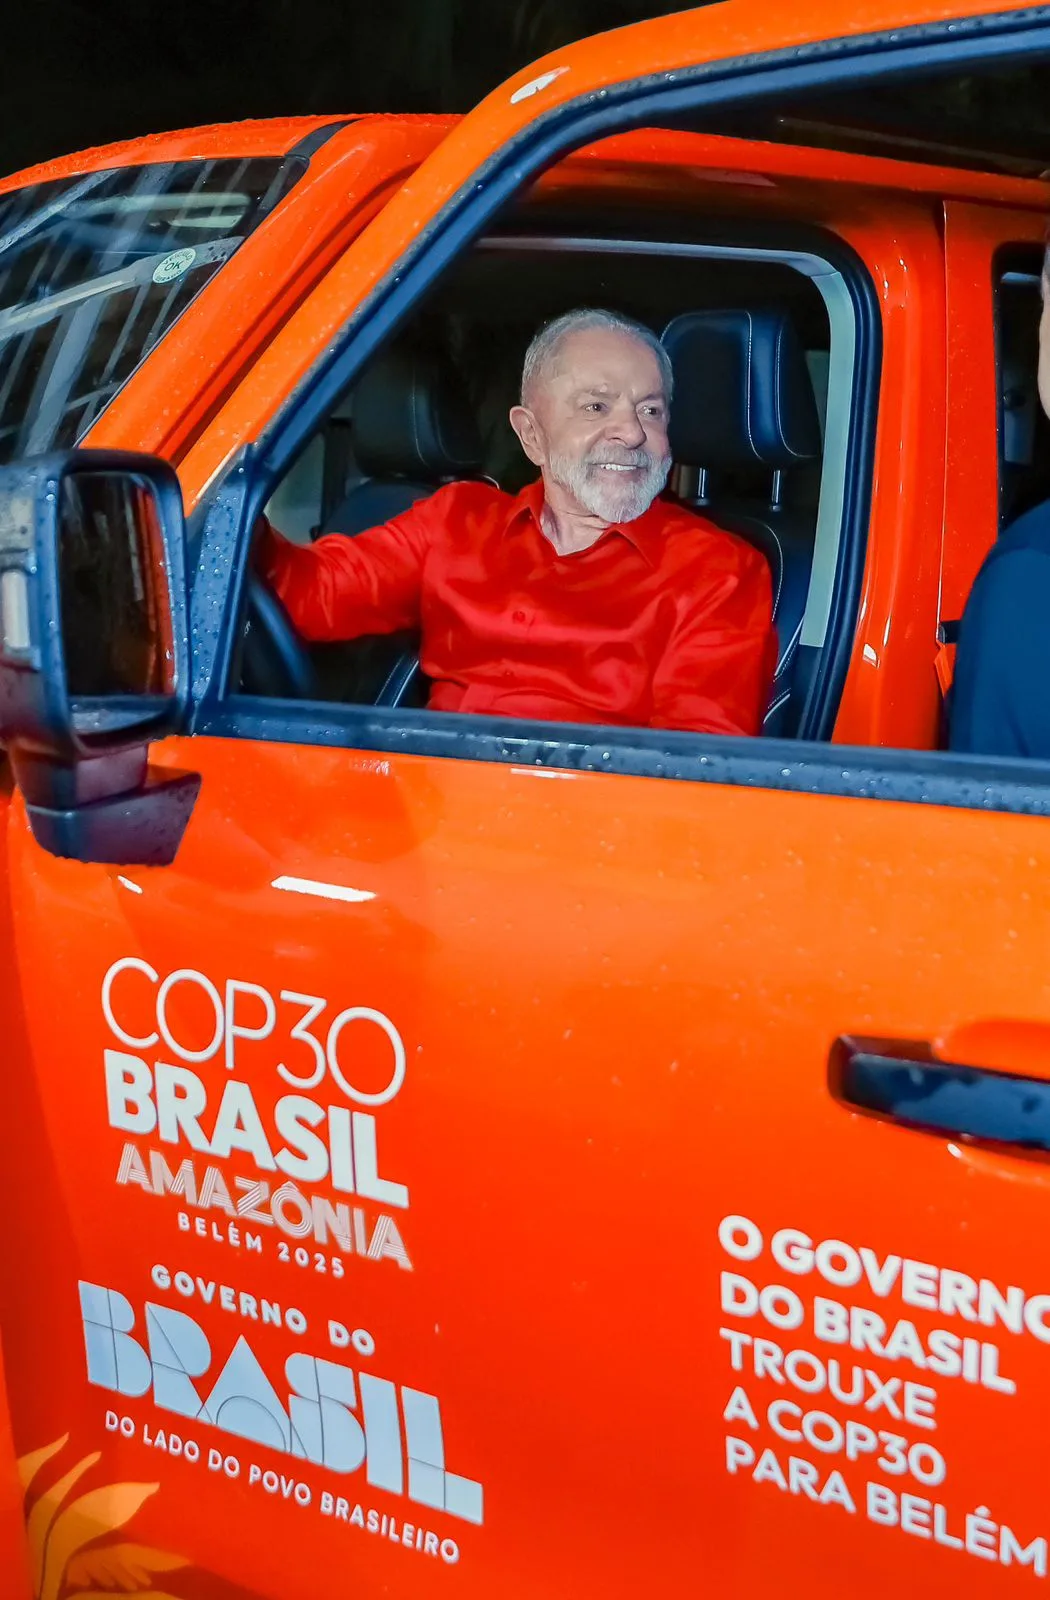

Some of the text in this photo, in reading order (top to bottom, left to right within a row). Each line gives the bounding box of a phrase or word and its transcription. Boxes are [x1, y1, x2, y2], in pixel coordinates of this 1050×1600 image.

[164, 260, 184, 271] OK
[101, 957, 406, 1106] COP30
[104, 1048, 410, 1209] BRASIL
[116, 1142, 413, 1271] AMAZÔNIA
[178, 1211, 345, 1279] BELÉM 2025
[718, 1214, 764, 1261] O
[151, 1264, 376, 1357] GOVERNO DO
[720, 1270, 1017, 1395] DO BRASIL
[78, 1279, 484, 1526] BRASIL
[719, 1327, 937, 1430] TROUXE
[723, 1386, 947, 1487] A COP30
[105, 1410, 460, 1564] DO LADO DO POVO BRASILEIRO
[725, 1435, 1048, 1577] PARA BELÉM
